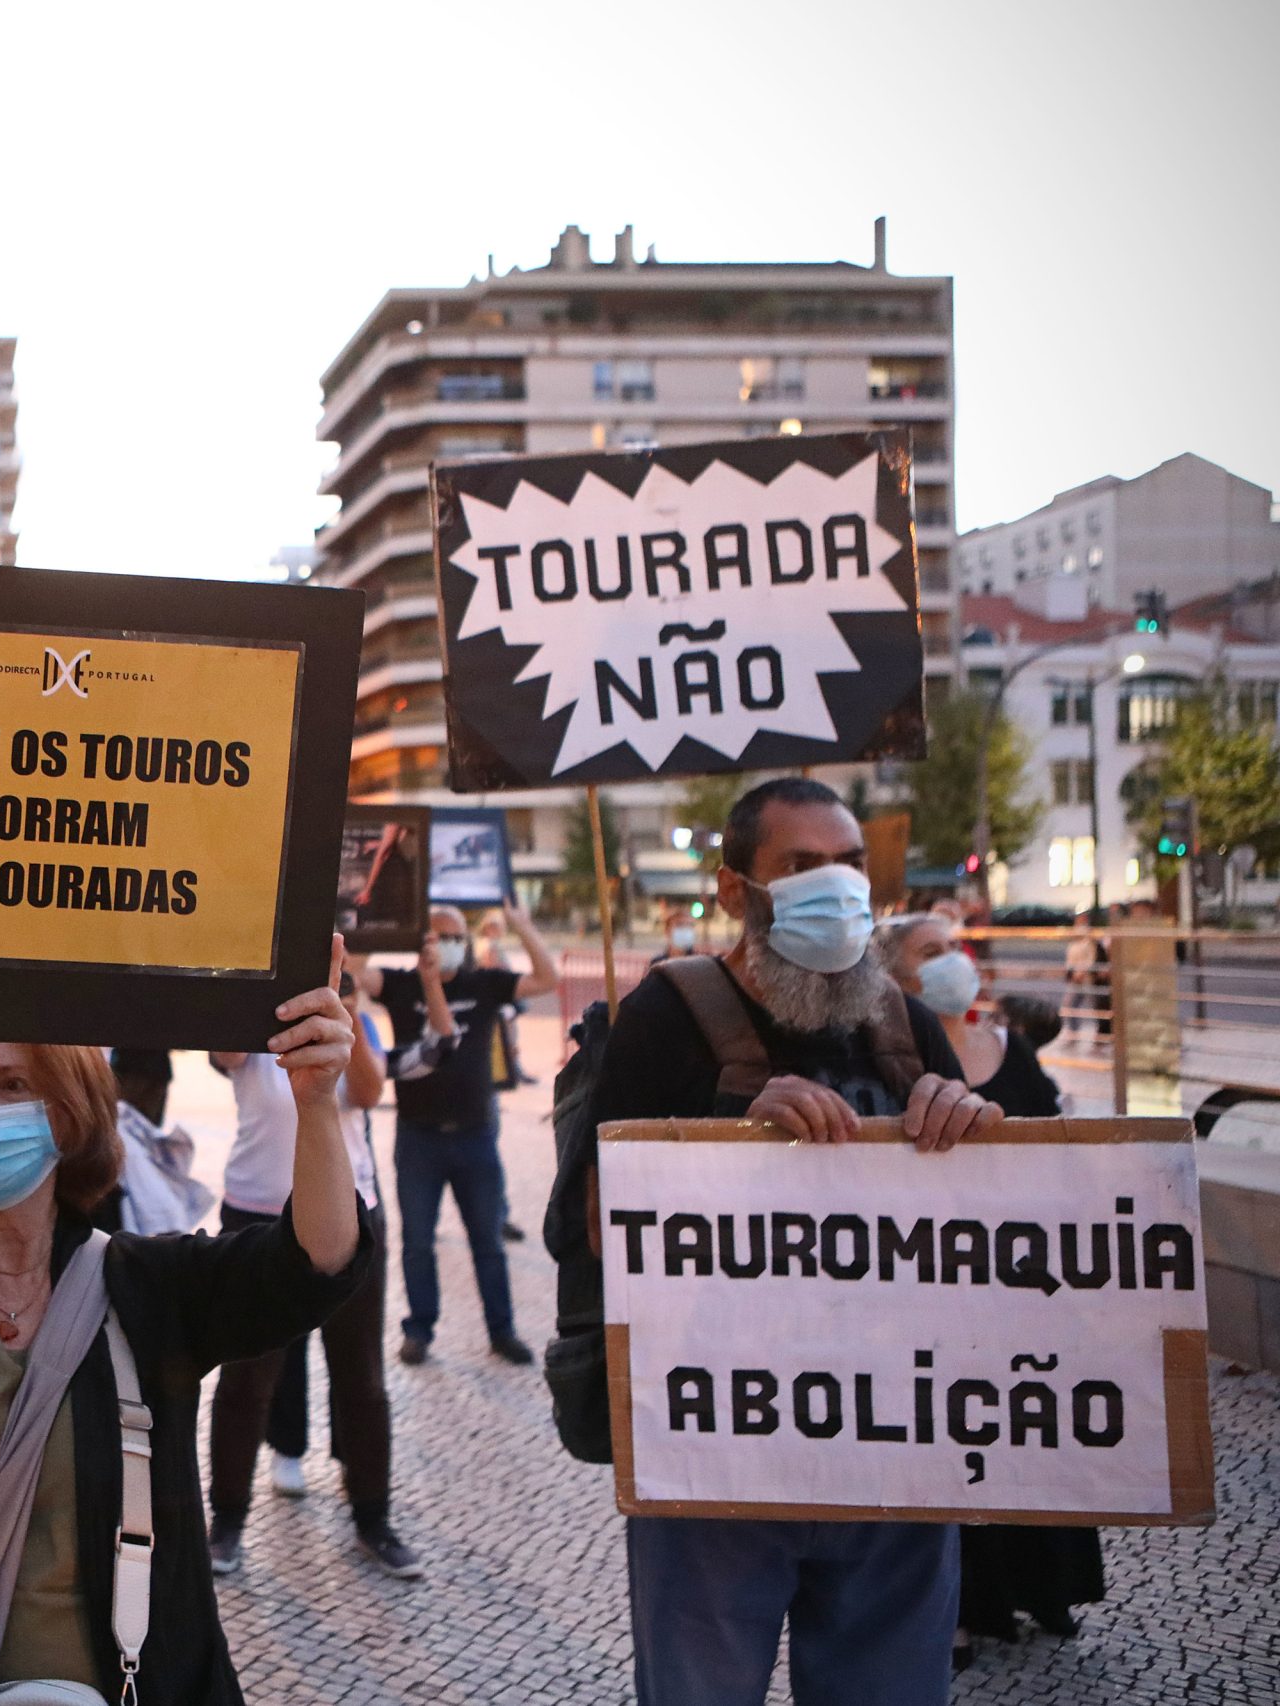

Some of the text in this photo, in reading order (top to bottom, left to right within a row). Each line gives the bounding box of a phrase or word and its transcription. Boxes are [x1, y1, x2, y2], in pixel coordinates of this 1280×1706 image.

[478, 513, 870, 611] TOURADA
[5, 666, 41, 675] DIRECTA
[89, 670, 155, 682] PORTUGAL
[594, 619, 784, 725] NÃO
[10, 729, 68, 778] OS
[80, 733, 251, 787] TOUROS
